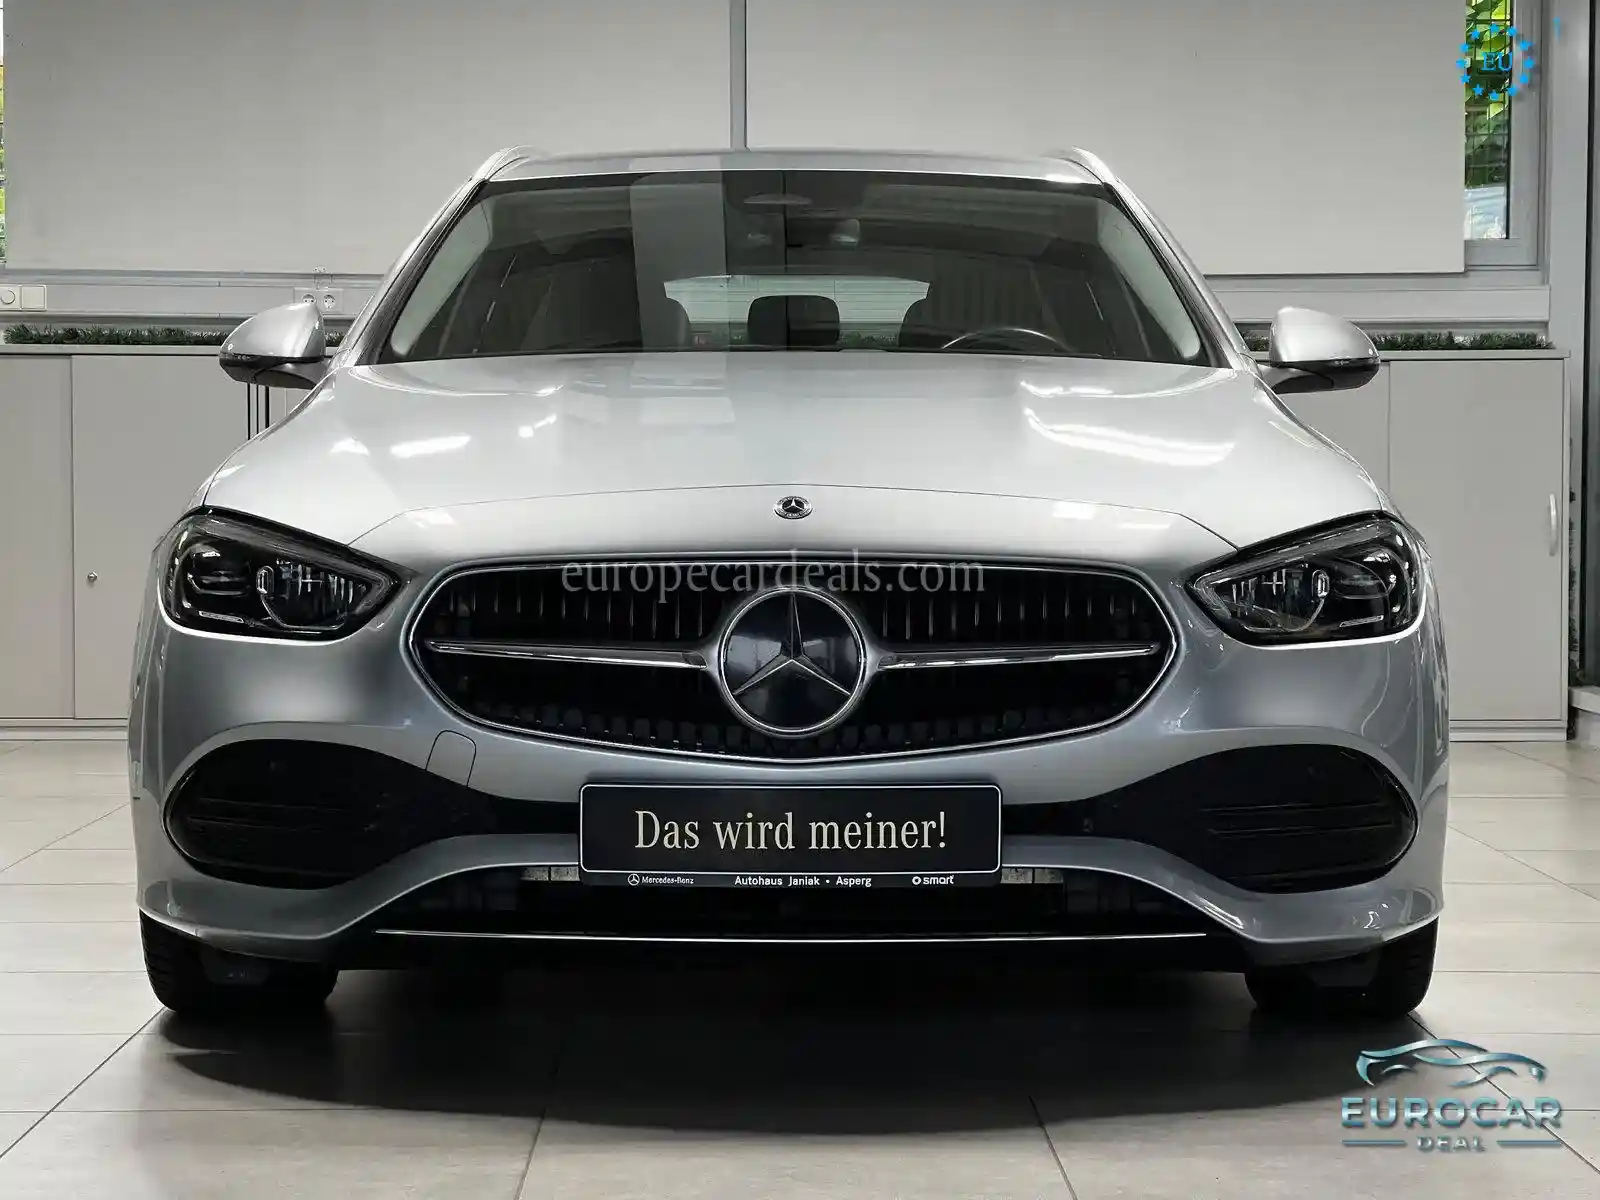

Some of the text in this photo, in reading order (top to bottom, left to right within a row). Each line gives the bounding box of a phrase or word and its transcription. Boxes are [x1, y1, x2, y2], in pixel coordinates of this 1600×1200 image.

[634, 810, 947, 850] Das wird meiner!
[641, 876, 695, 885] Mercedes-Benz
[734, 875, 873, 888] Autohaus Janiak Asperg
[922, 875, 955, 885] smart
